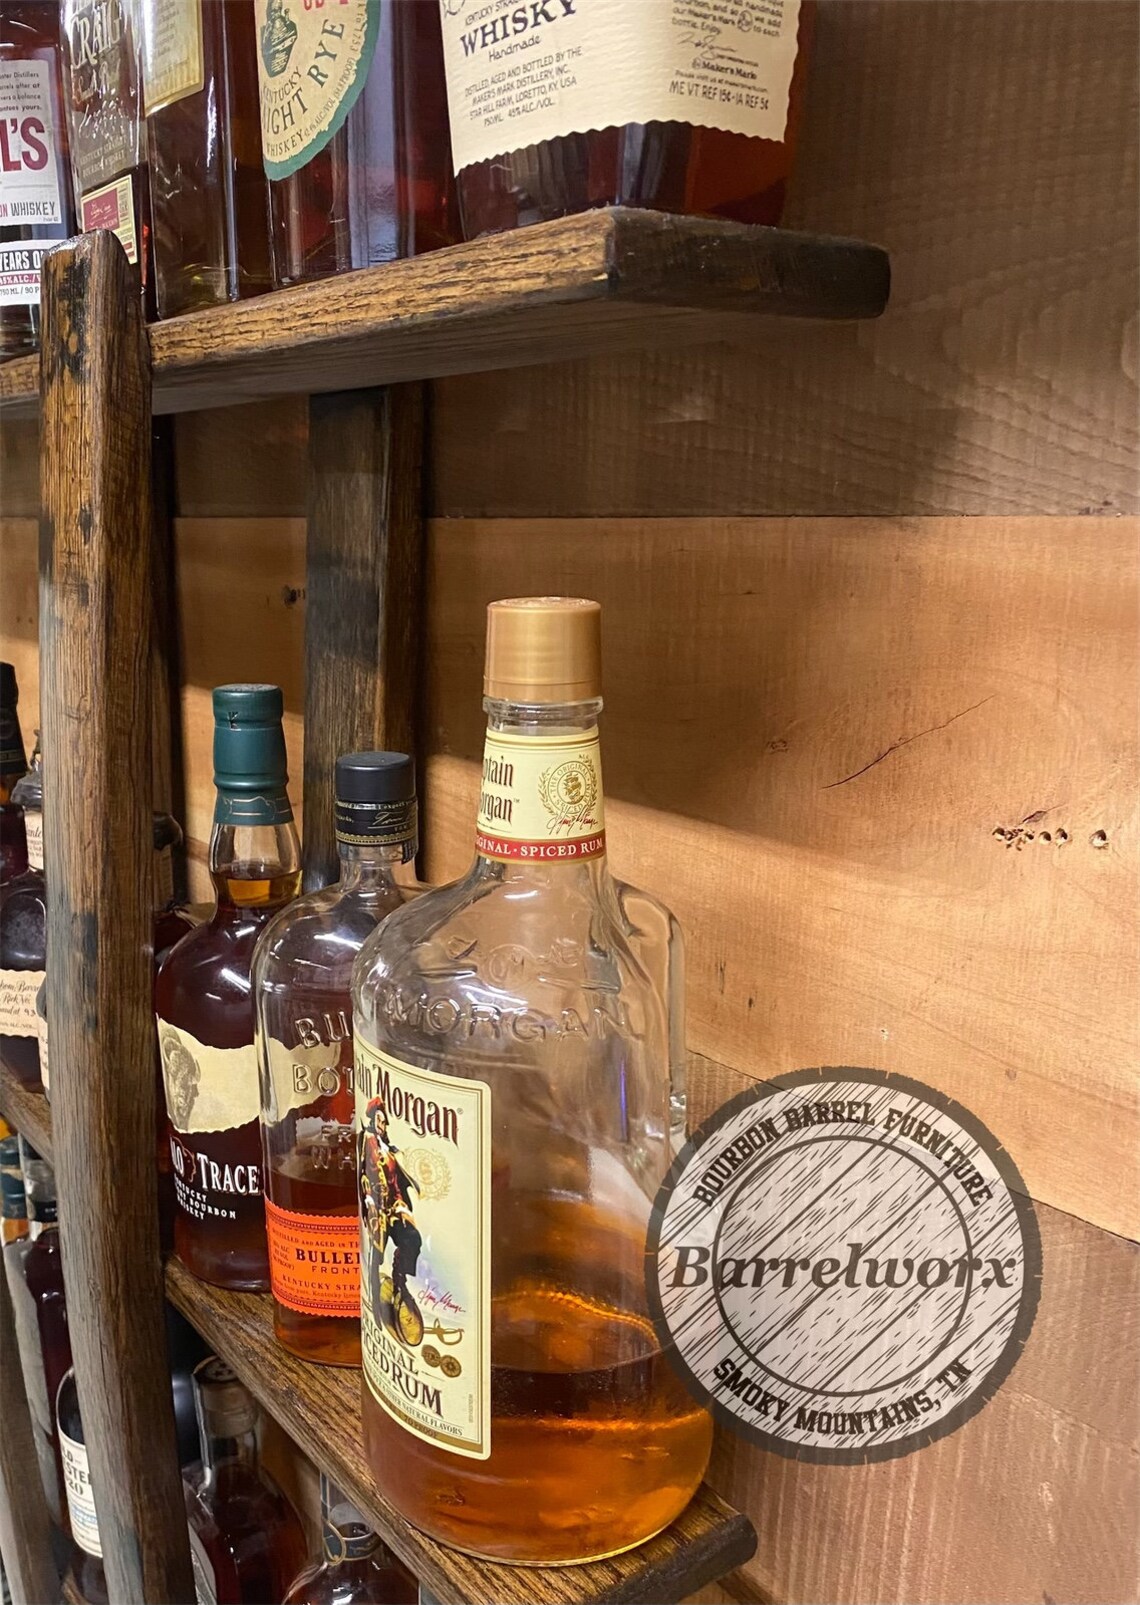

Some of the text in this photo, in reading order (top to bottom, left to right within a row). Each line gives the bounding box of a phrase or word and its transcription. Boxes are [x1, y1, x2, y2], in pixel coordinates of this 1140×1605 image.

[459, 0, 577, 57] WHISKY
[488, 35, 542, 62] Handmade
[490, 71, 507, 85] AGED
[507, 65, 521, 78] AND
[522, 55, 554, 75] BOTTLED
[555, 51, 566, 63] BY
[567, 45, 583, 60] THE
[702, 60, 758, 81] Maker's Mark
[560, 75, 578, 90] USA
[669, 80, 685, 96] ME
[687, 81, 701, 98] VT
[702, 84, 718, 101] REF
[745, 93, 760, 110] REF
[263, 86, 308, 135] IGHT
[10, 202, 56, 217] WHISKEY
[32, 250, 44, 270] O
[475, 835, 604, 857] GINAL SPICED RUM
[372, 1063, 460, 1150] Morgan
[189, 1197, 236, 1219] BOURBON
[282, 1273, 330, 1291] KENTUCKY
[391, 1360, 444, 1420] RUM
[430, 1418, 463, 1436] FLAVORS
